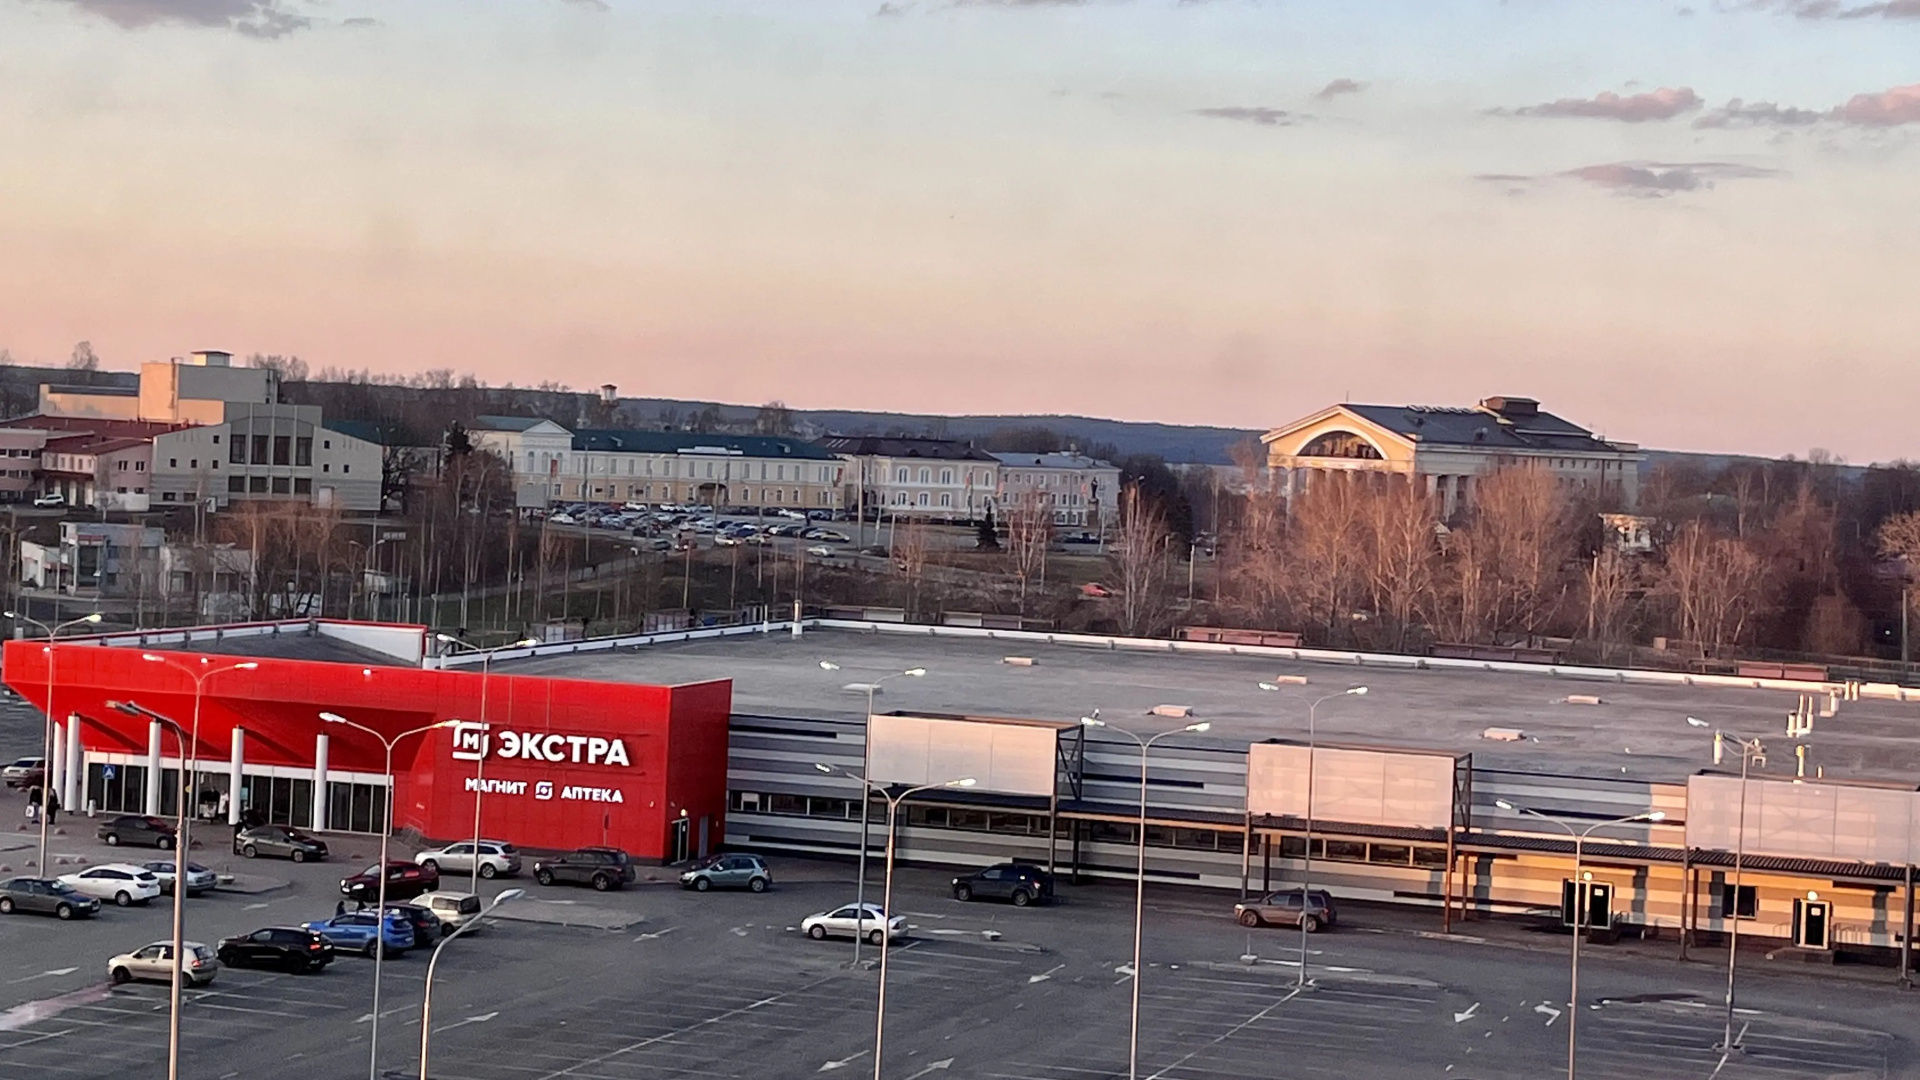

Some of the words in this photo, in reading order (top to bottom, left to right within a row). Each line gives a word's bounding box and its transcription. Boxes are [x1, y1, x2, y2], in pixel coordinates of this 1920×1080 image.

[497, 730, 630, 767] ЭКСТРА
[465, 777, 528, 795] МАГНИТ
[560, 786, 624, 803] АПТЕКА
